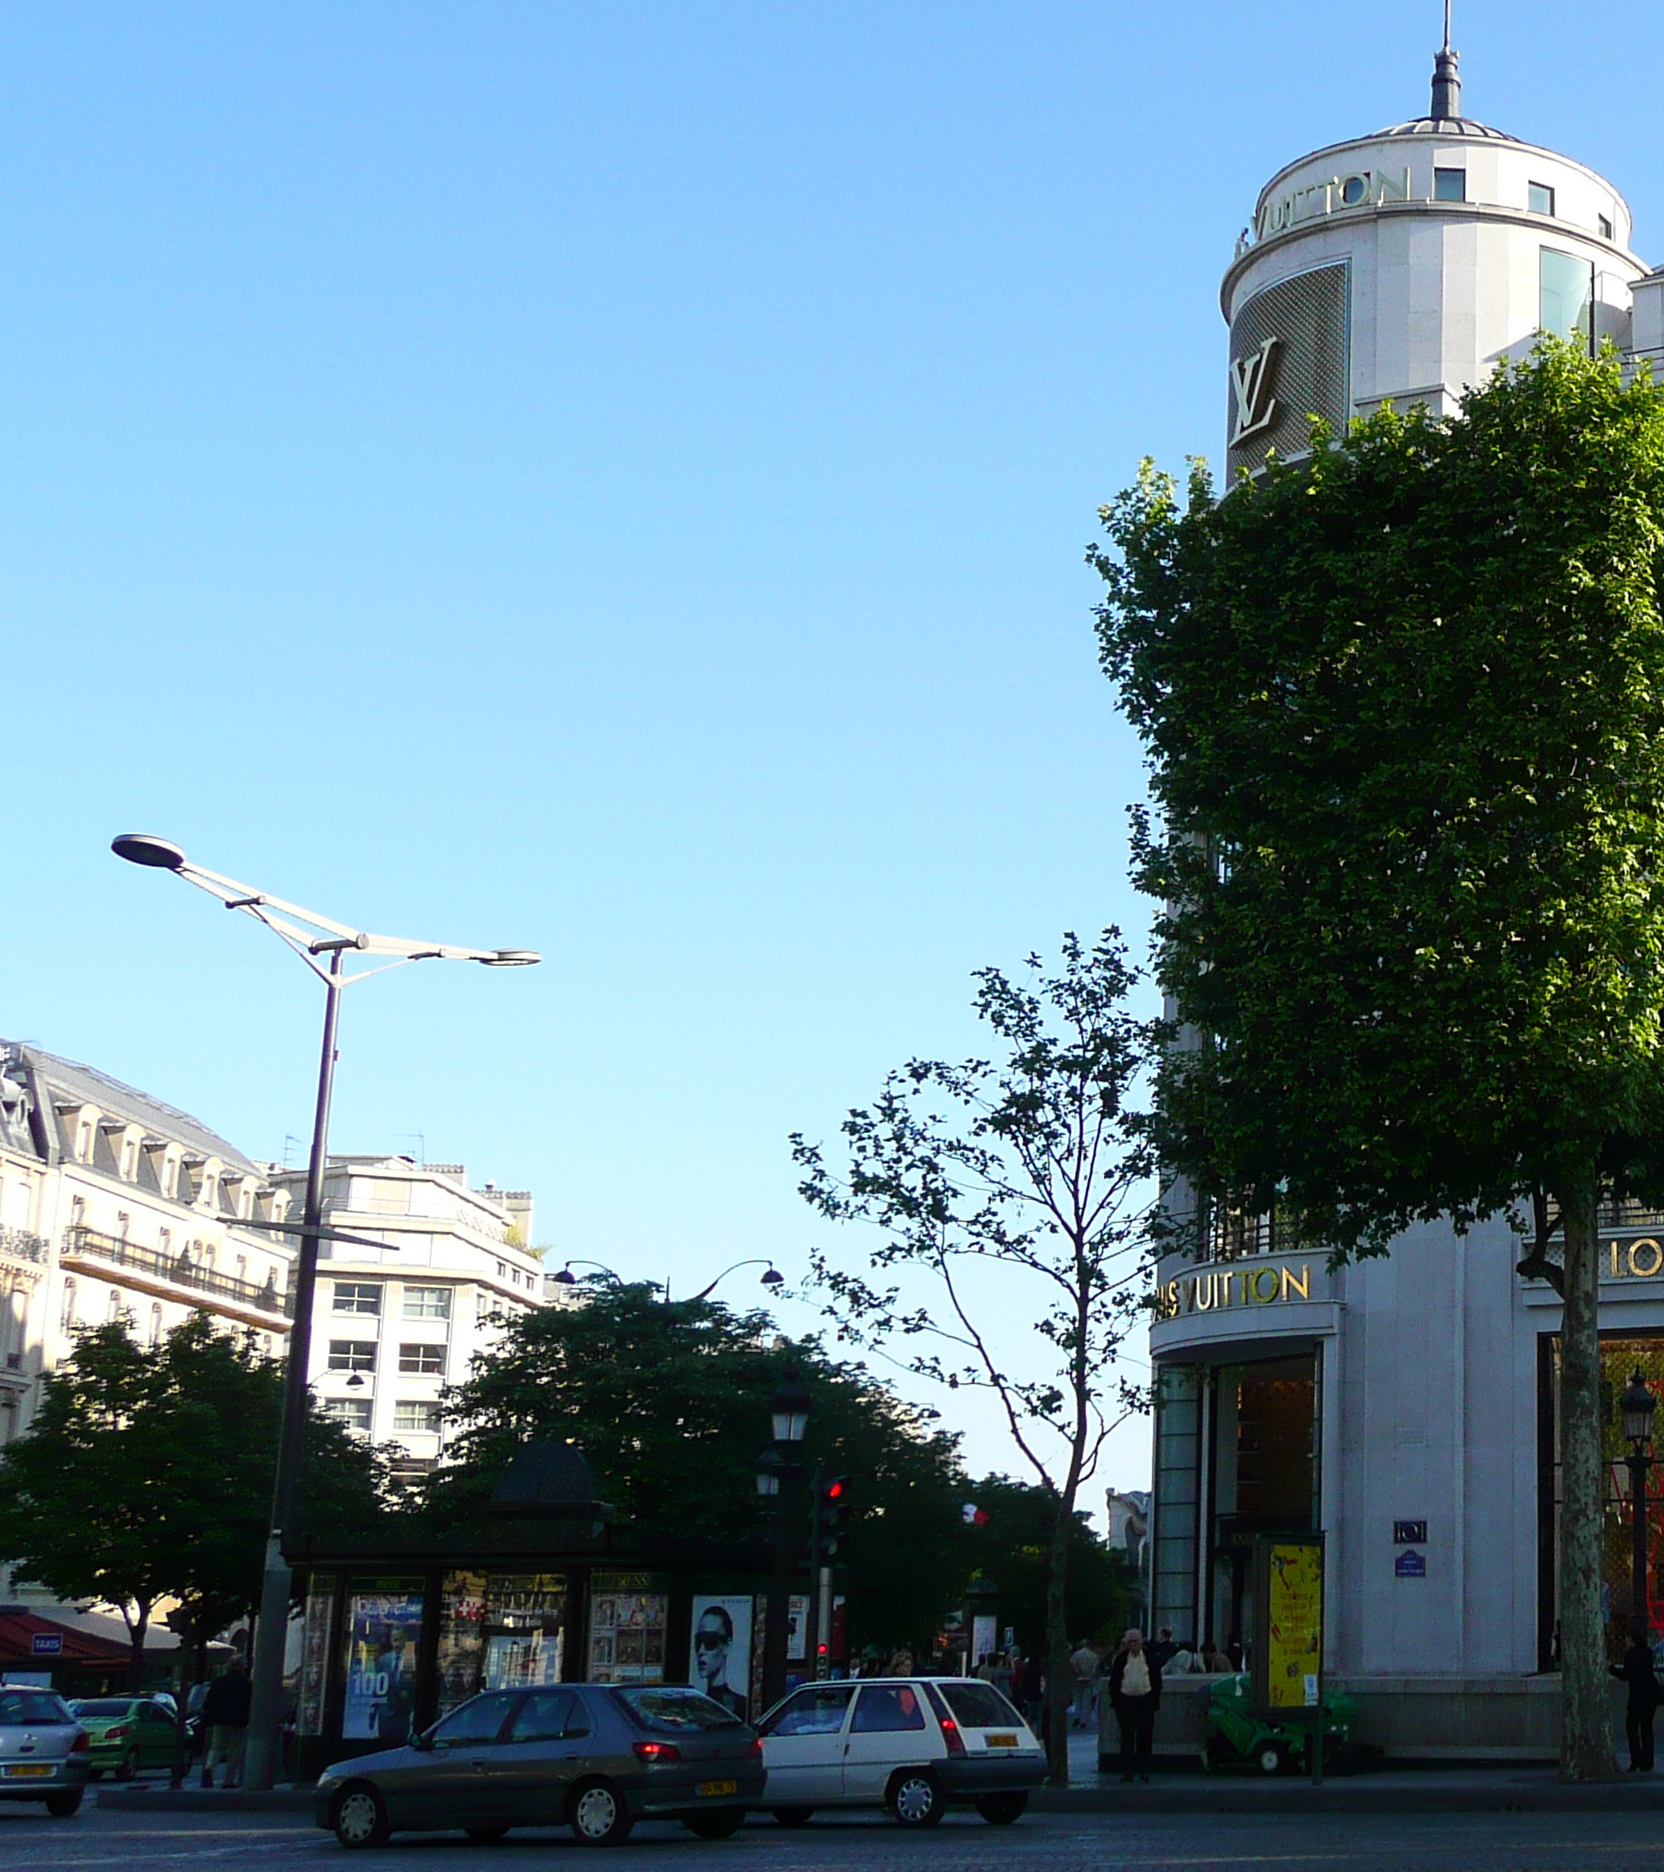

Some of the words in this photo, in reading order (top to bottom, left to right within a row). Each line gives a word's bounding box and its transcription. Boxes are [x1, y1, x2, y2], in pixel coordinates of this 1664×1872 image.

[1252, 166, 1411, 241] VUITTON
[1183, 1264, 1309, 1313] VUITTON
[353, 1671, 389, 1696] 100
